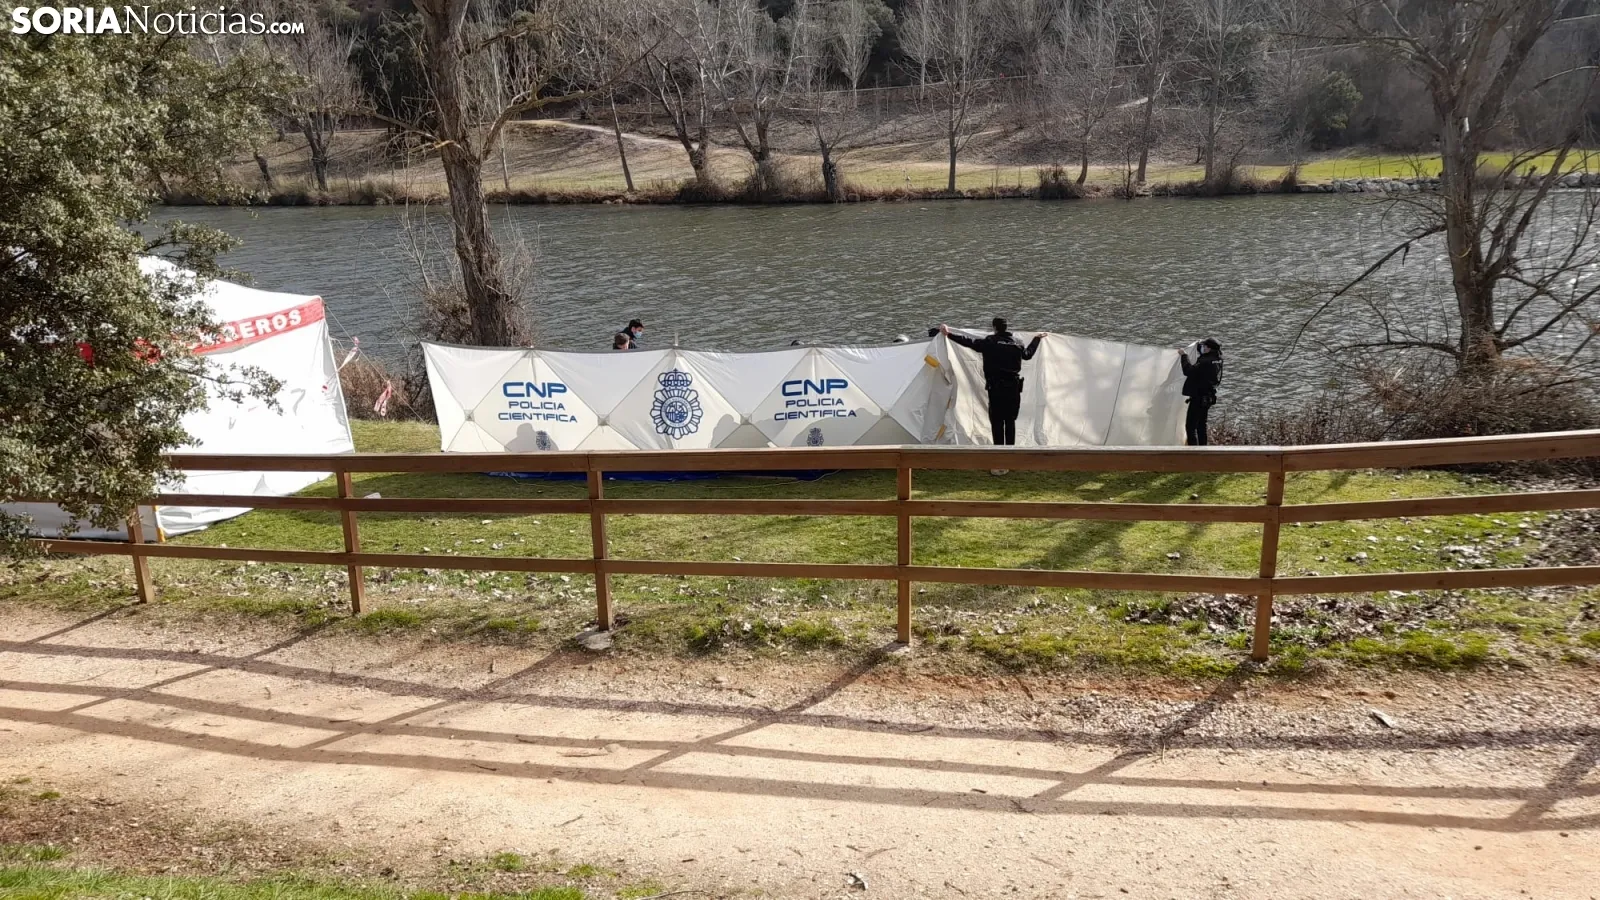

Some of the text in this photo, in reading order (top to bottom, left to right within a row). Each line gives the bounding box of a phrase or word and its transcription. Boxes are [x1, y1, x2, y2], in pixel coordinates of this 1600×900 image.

[503, 381, 567, 398] CNP
[782, 378, 848, 396] CNP
[508, 401, 565, 411] POLICIA
[786, 398, 844, 408] POLICIA
[498, 412, 578, 423] CIENTIFICA
[774, 409, 857, 421] CIENTIFICA
